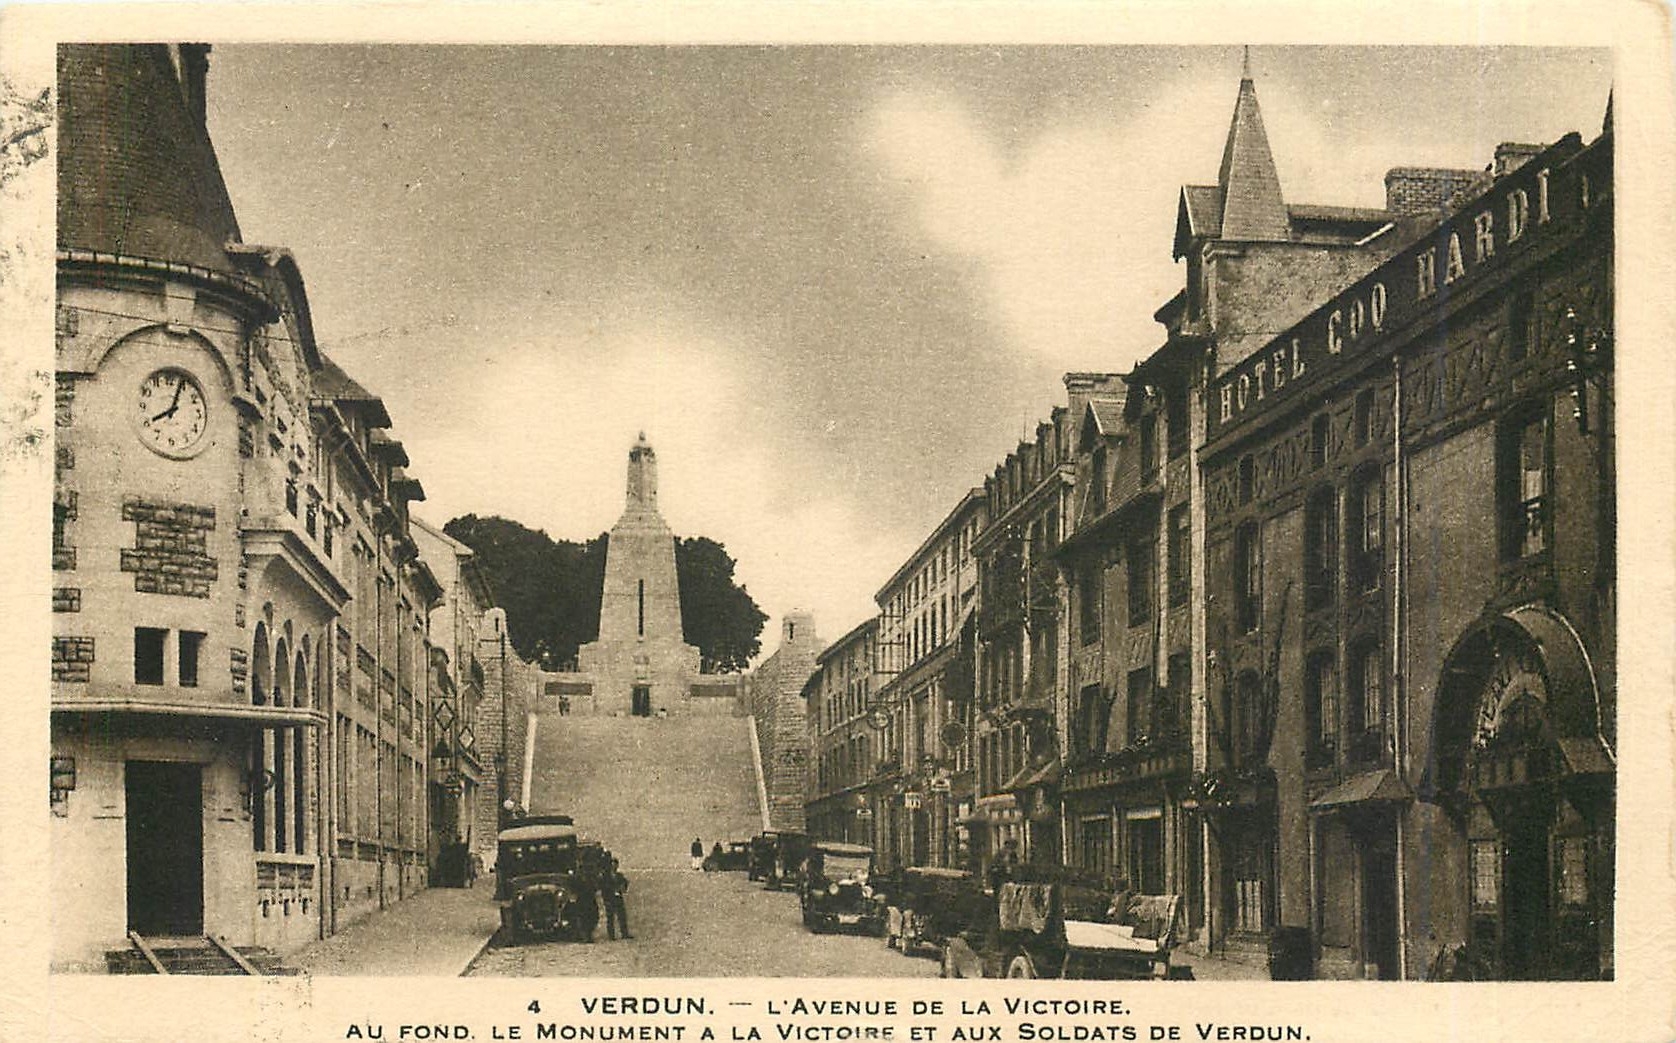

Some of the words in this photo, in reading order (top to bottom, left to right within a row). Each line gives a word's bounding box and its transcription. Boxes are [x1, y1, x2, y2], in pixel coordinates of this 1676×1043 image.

[1220, 337, 1306, 424] HOTEL
[1327, 282, 1387, 355] COQ
[1416, 167, 1551, 299] HARDI
